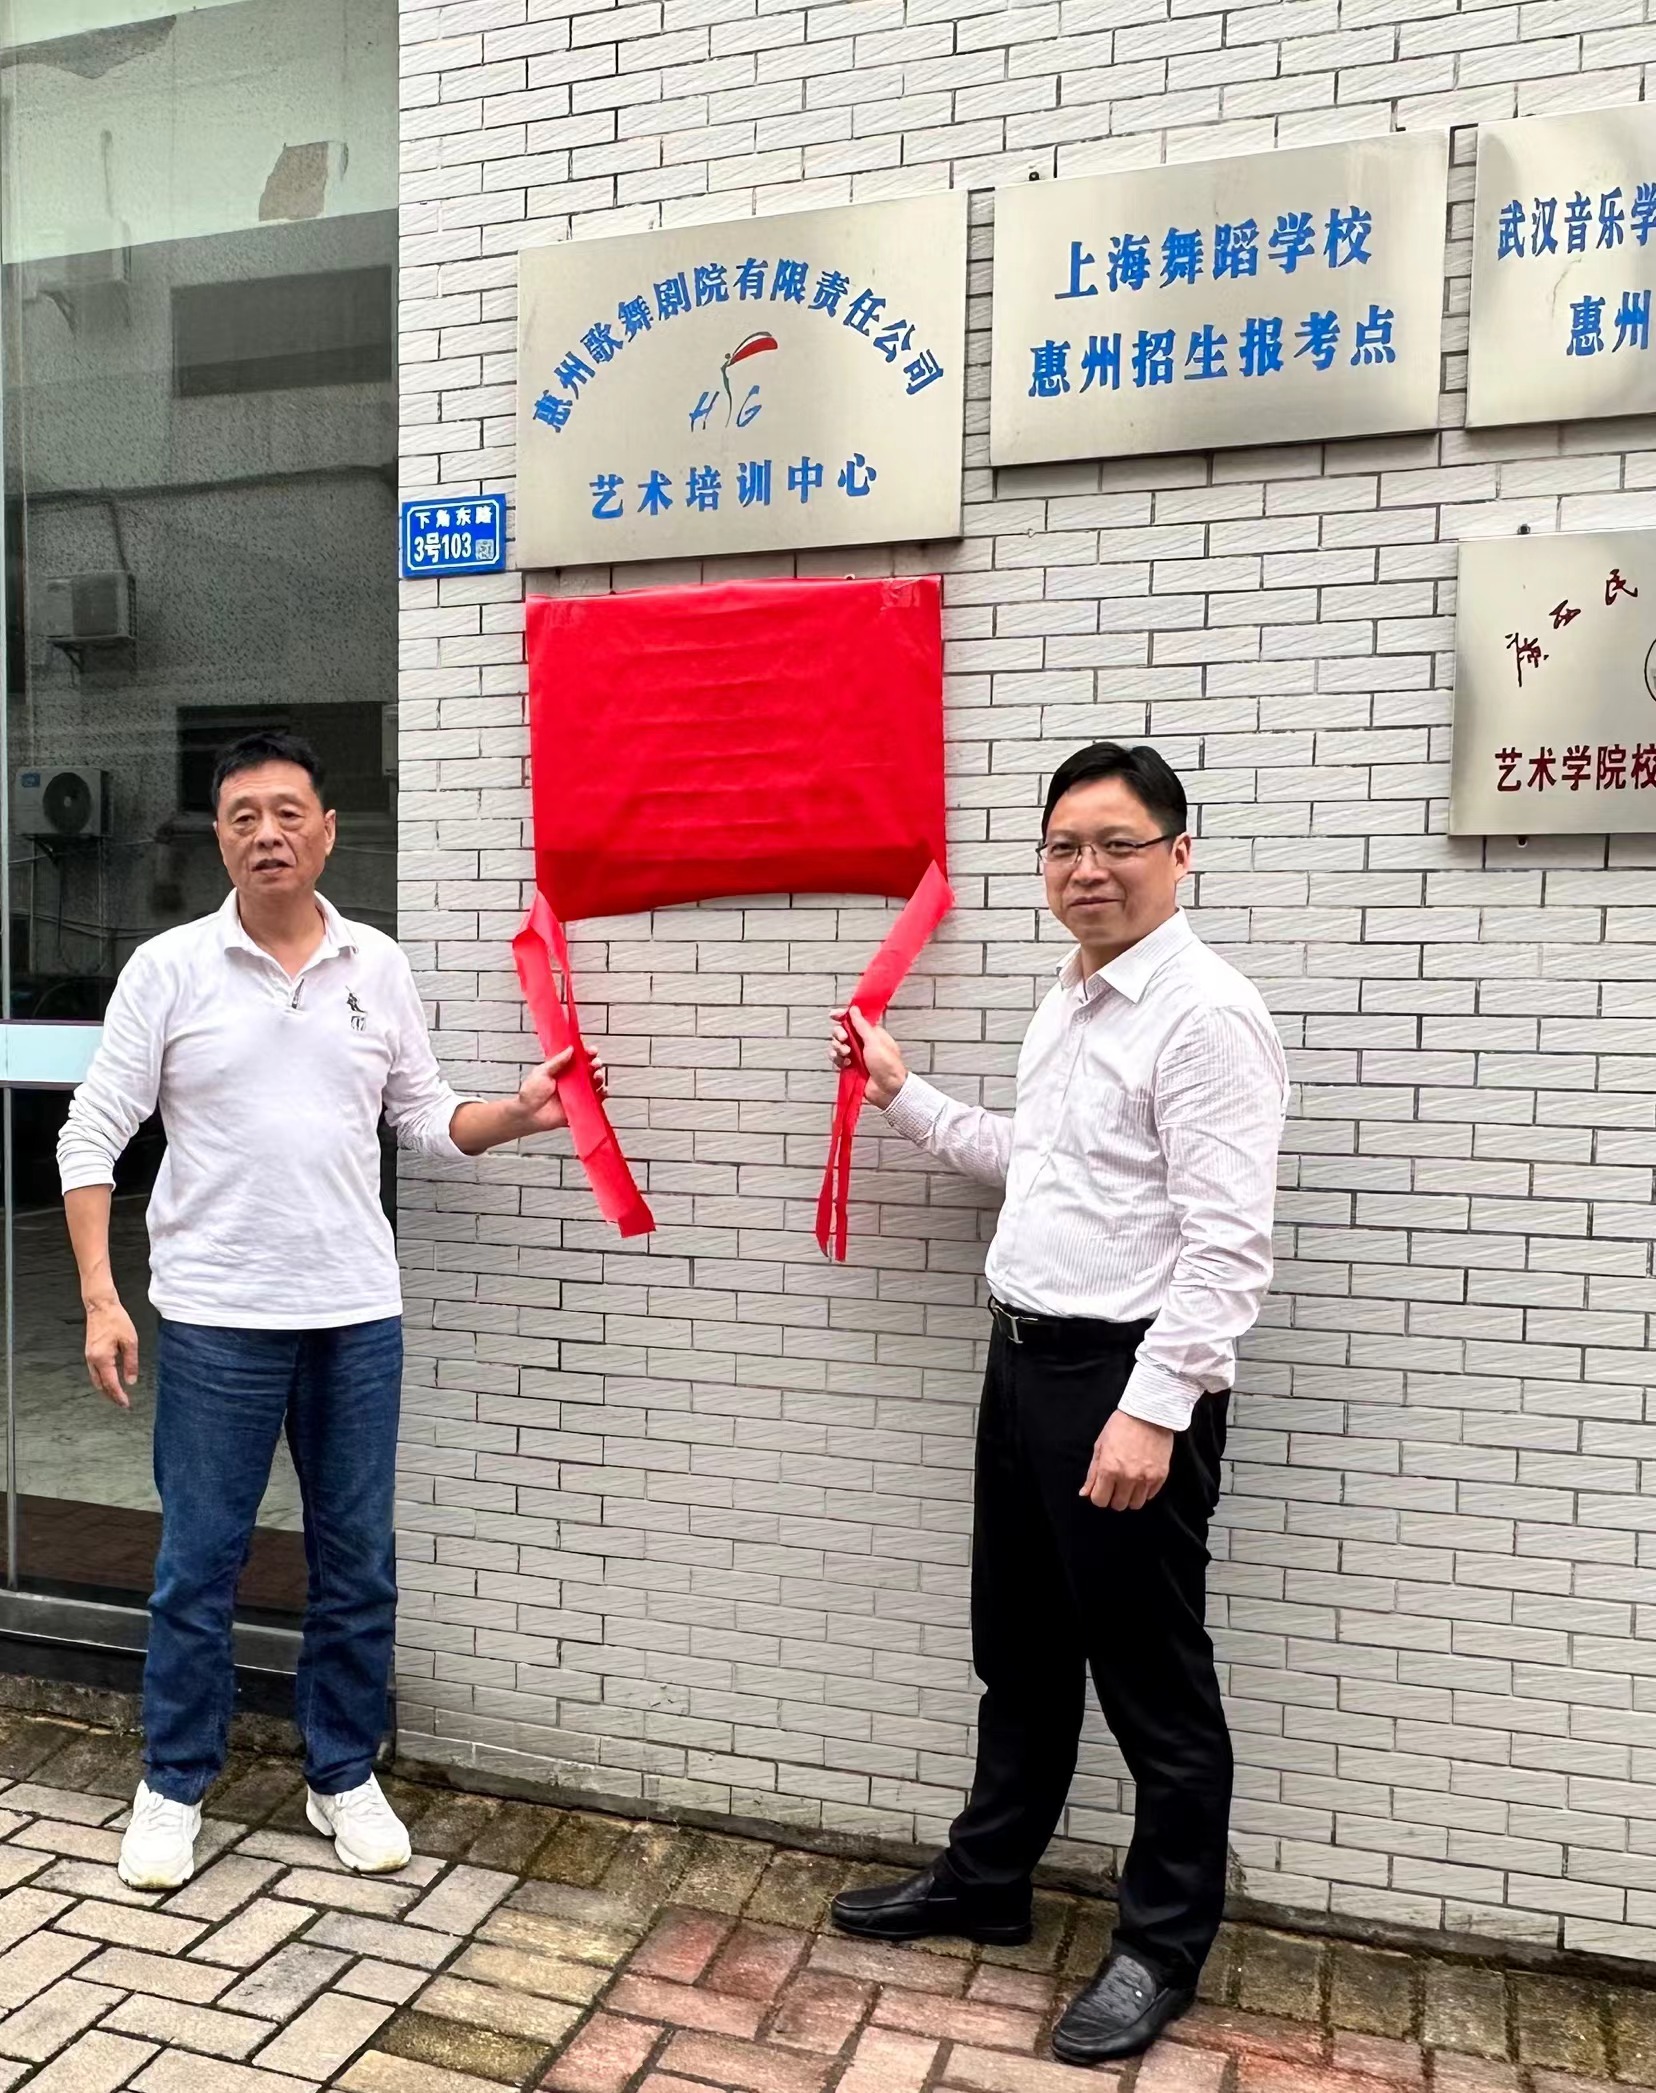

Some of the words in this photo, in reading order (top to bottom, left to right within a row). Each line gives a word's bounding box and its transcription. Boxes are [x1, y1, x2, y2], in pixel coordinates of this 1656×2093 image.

[1054, 206, 1373, 300] 上海舞蹈学校
[1498, 182, 1656, 260] 武汉音乐学
[533, 257, 945, 433] 惠州歌舞剧院有限责任公司
[1028, 304, 1397, 398] 惠州招生报考点
[1566, 290, 1652, 356] 惠州
[589, 452, 877, 520] 艺术培训中心
[414, 532, 472, 563] 3号103
[1495, 743, 1656, 792] 艺术学院校
